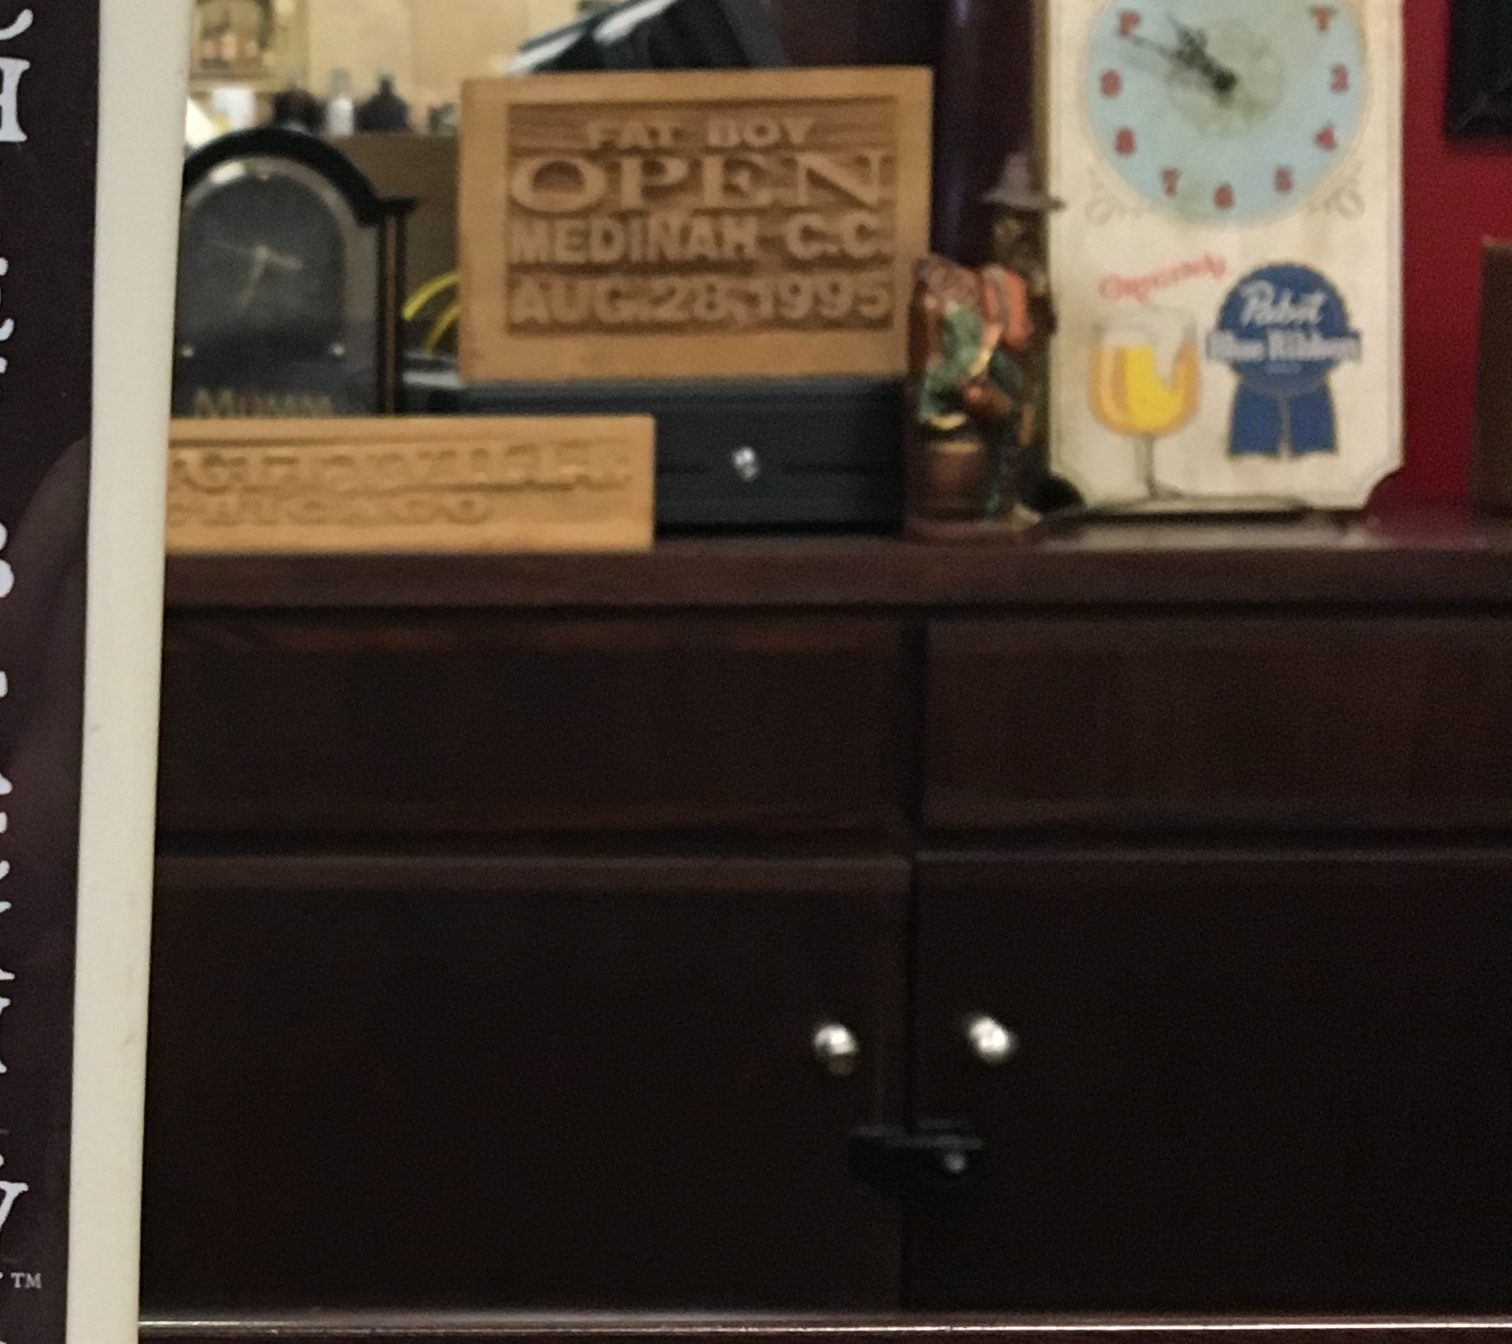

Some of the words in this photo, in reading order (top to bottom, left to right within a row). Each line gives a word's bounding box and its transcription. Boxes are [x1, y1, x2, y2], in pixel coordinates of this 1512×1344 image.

[589, 119, 686, 149] FAT
[706, 116, 816, 148] BOY
[510, 150, 890, 214] OPEN
[510, 209, 759, 264] MEDINAH
[1240, 278, 1328, 327] Pabst
